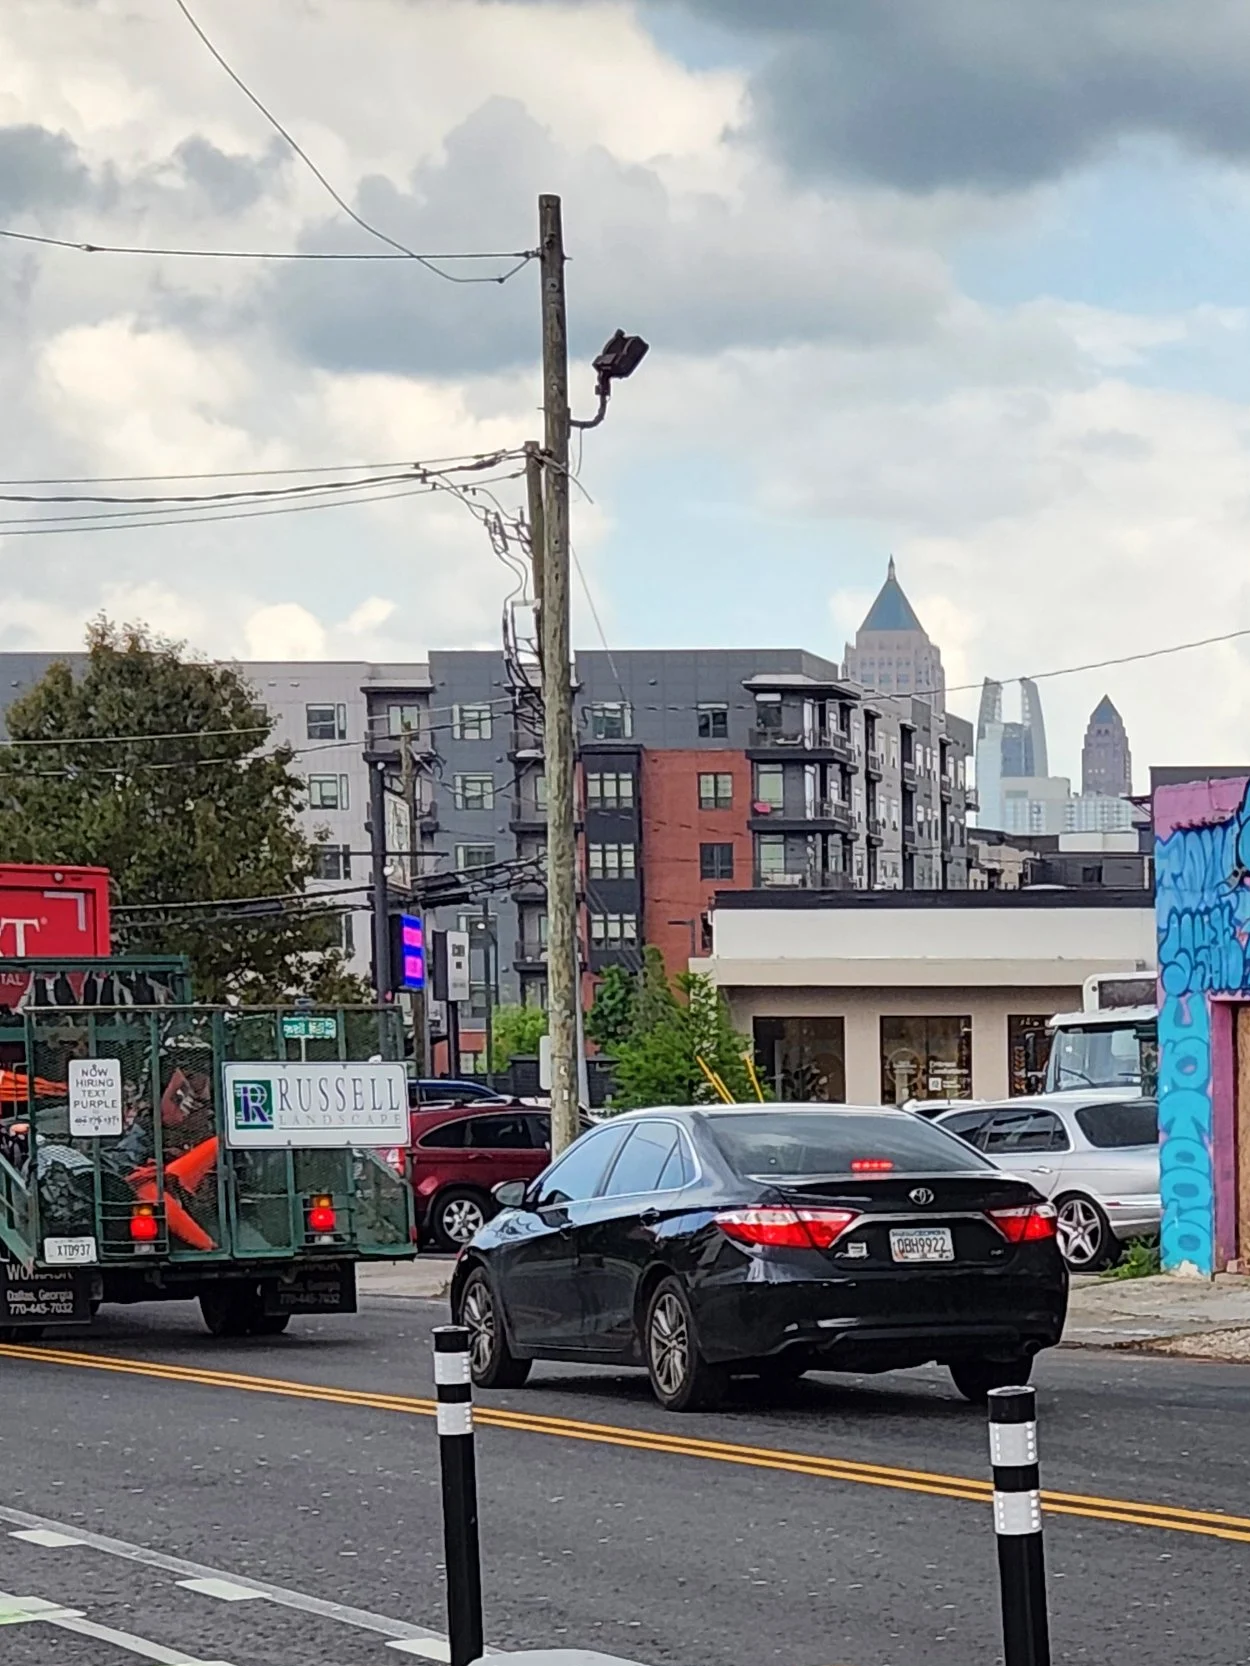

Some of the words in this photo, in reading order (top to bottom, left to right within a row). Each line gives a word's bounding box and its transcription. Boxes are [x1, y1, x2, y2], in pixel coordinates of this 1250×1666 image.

[81, 1068, 108, 1077] NOW
[75, 1079, 114, 1088] HIRING
[81, 1089, 107, 1098] TEXT
[277, 1077, 400, 1112] RUSSELL
[73, 1100, 118, 1109] PURPLE
[279, 1113, 401, 1126] LANDSCAPE
